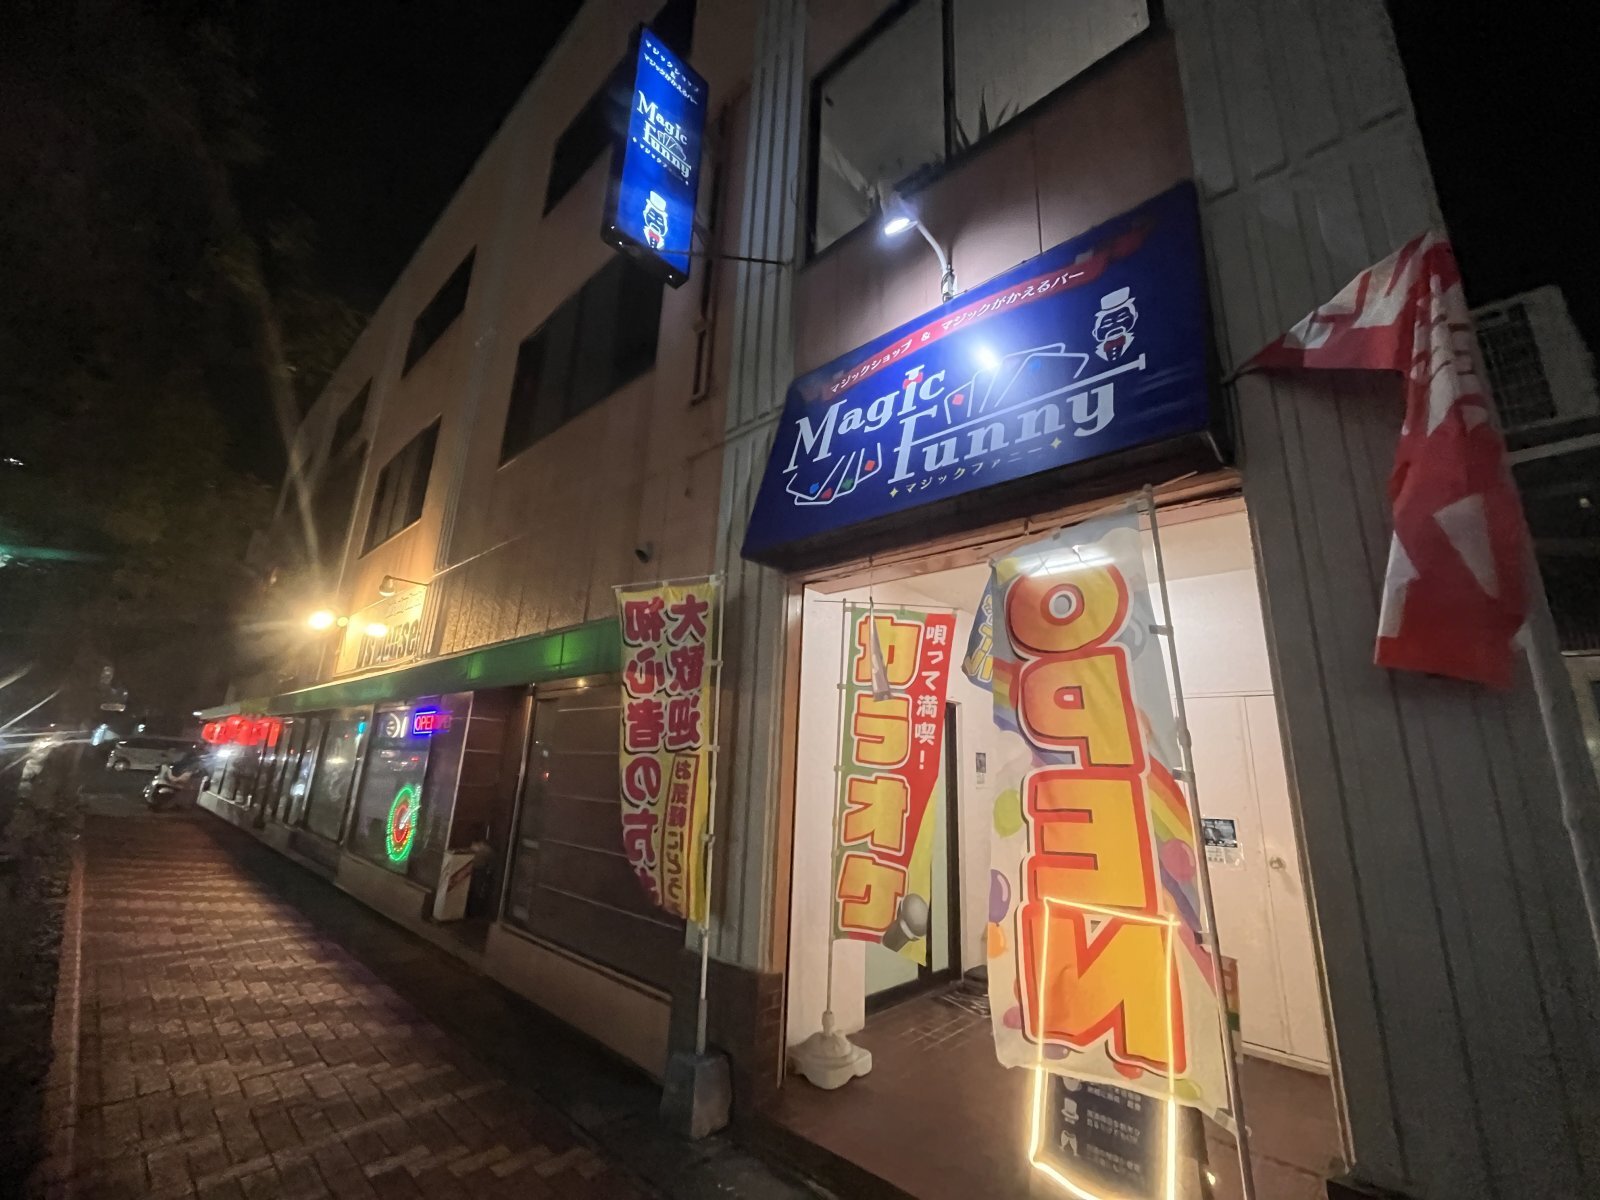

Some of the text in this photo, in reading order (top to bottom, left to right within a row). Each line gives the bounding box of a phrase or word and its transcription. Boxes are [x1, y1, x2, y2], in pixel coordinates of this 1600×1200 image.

[637, 90, 688, 146] Magic
[643, 121, 692, 179] Funny
[830, 270, 1085, 394] マジックショップ & マジックがかえるバー
[782, 364, 946, 474] Magic
[887, 354, 1146, 485] Funny
[905, 446, 1043, 494] マジックファニー
[914, 624, 948, 770] 唄って満喫！
[838, 615, 924, 932] カラオケ
